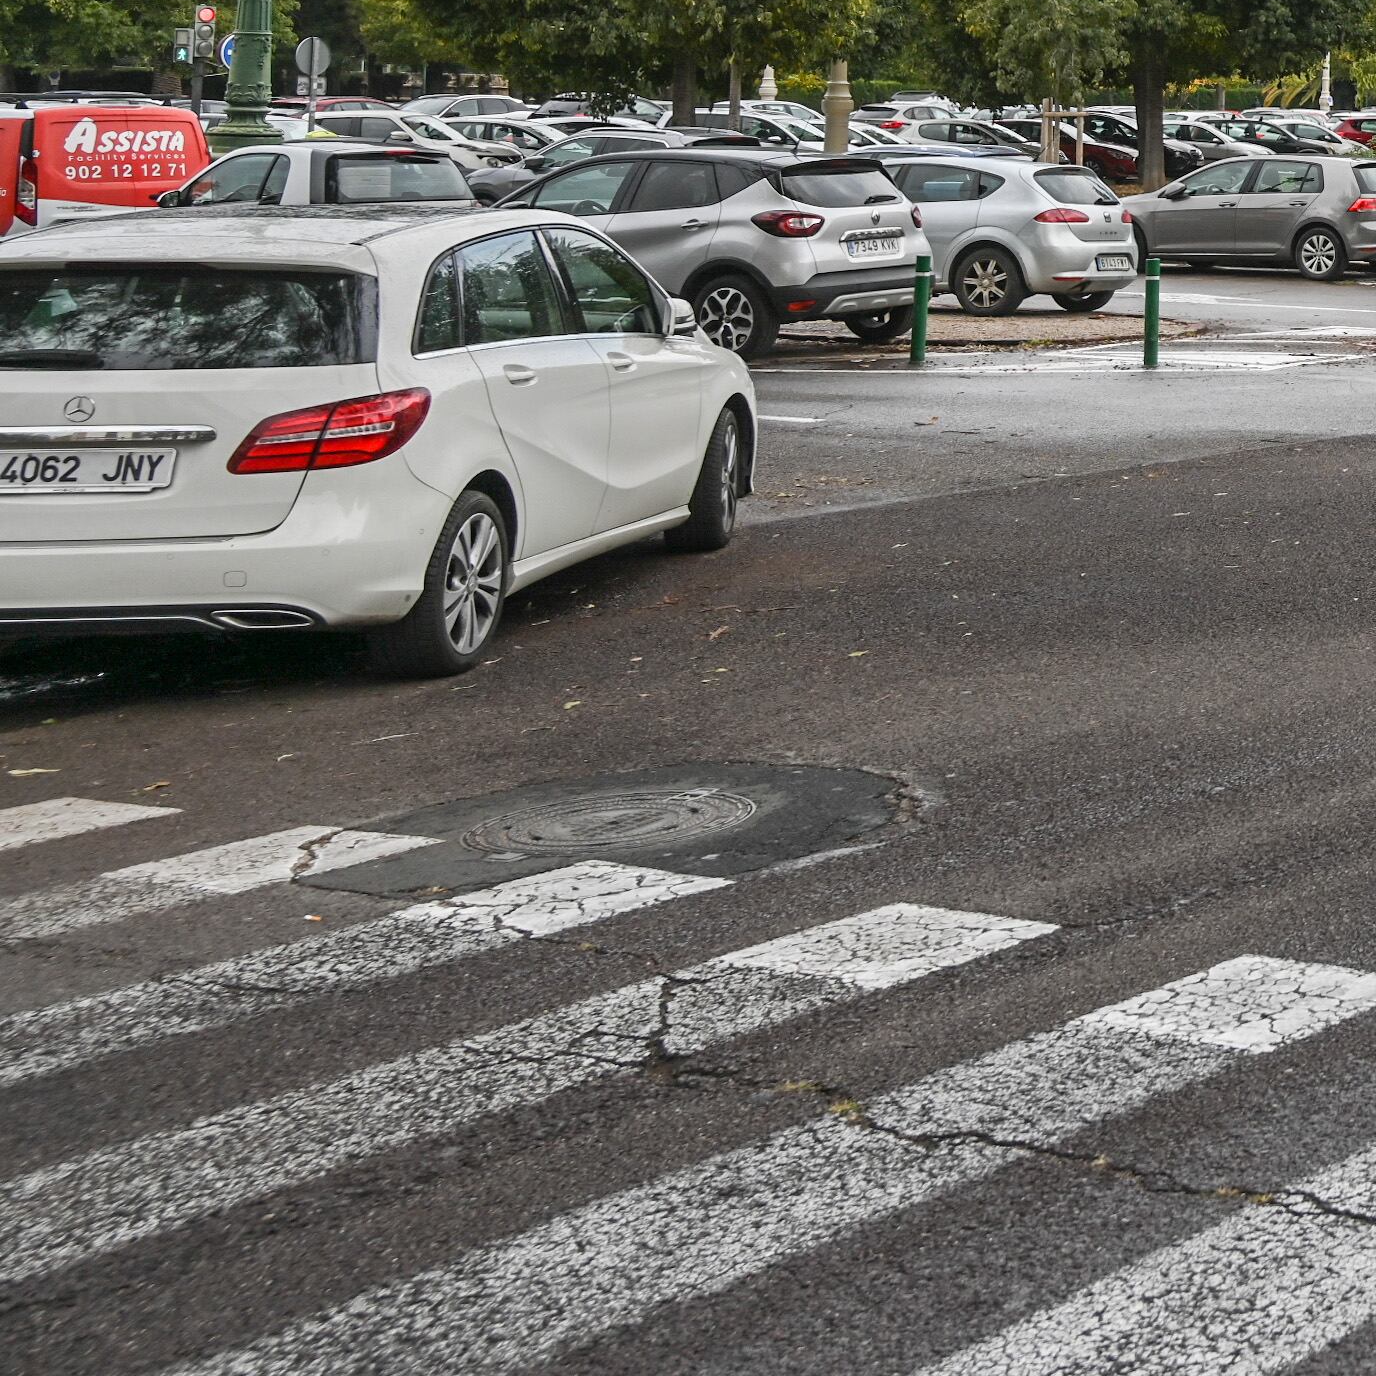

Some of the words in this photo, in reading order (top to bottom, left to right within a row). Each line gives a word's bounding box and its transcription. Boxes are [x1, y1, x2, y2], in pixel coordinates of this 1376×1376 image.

[63, 117, 185, 154] ASSISTA
[68, 154, 126, 162] Facility
[131, 153, 186, 161] Services
[65, 165, 103, 180] 902
[111, 164, 133, 178] 12
[141, 163, 161, 177] 12
[168, 163, 187, 176] 71
[854, 240, 879, 253] 7349
[880, 239, 897, 251] KVK
[0, 455, 81, 483] 4062
[102, 454, 165, 482] JNY
